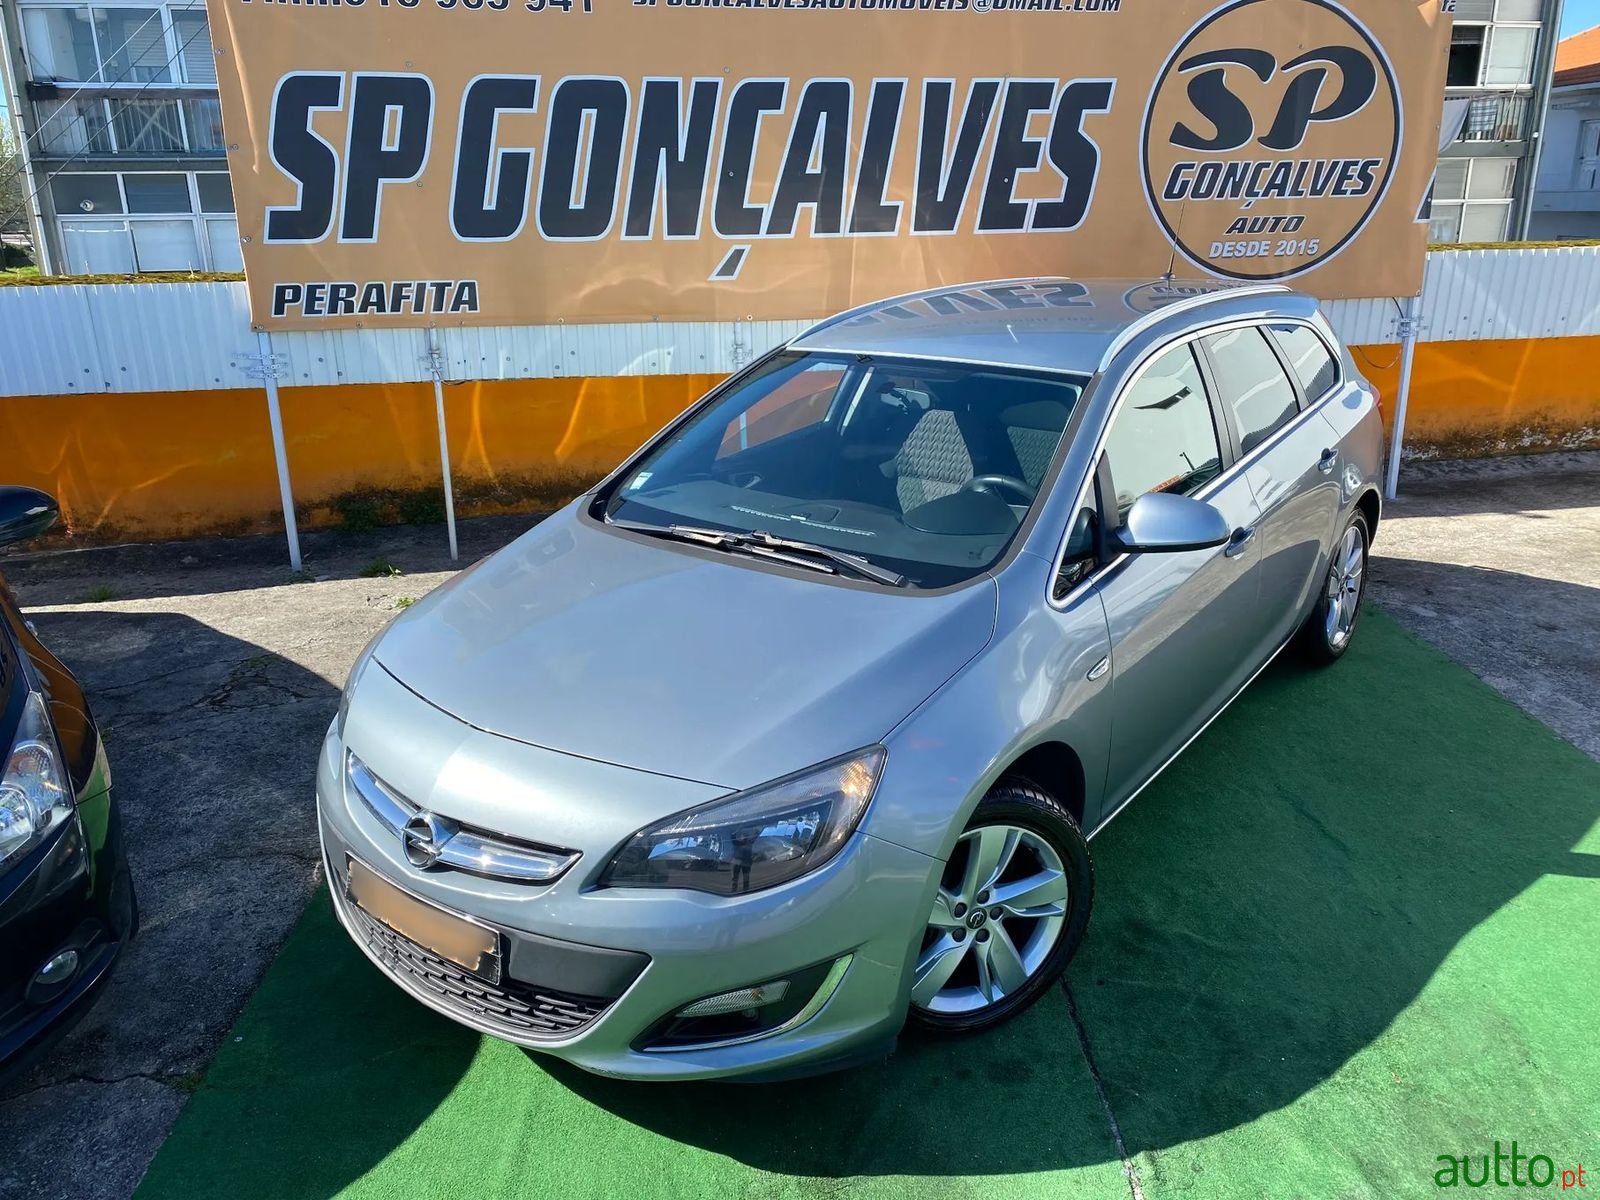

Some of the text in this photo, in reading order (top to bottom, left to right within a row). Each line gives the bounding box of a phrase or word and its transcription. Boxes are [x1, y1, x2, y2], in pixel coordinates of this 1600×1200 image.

[1168, 45, 1377, 151] SP
[263, 70, 1117, 281] SP GONÇALVES
[1162, 157, 1384, 210] GONÇALVES
[1223, 215, 1306, 236] AUTO
[1208, 238, 1320, 259] DESDE 2015
[271, 279, 480, 317] PERAFITA
